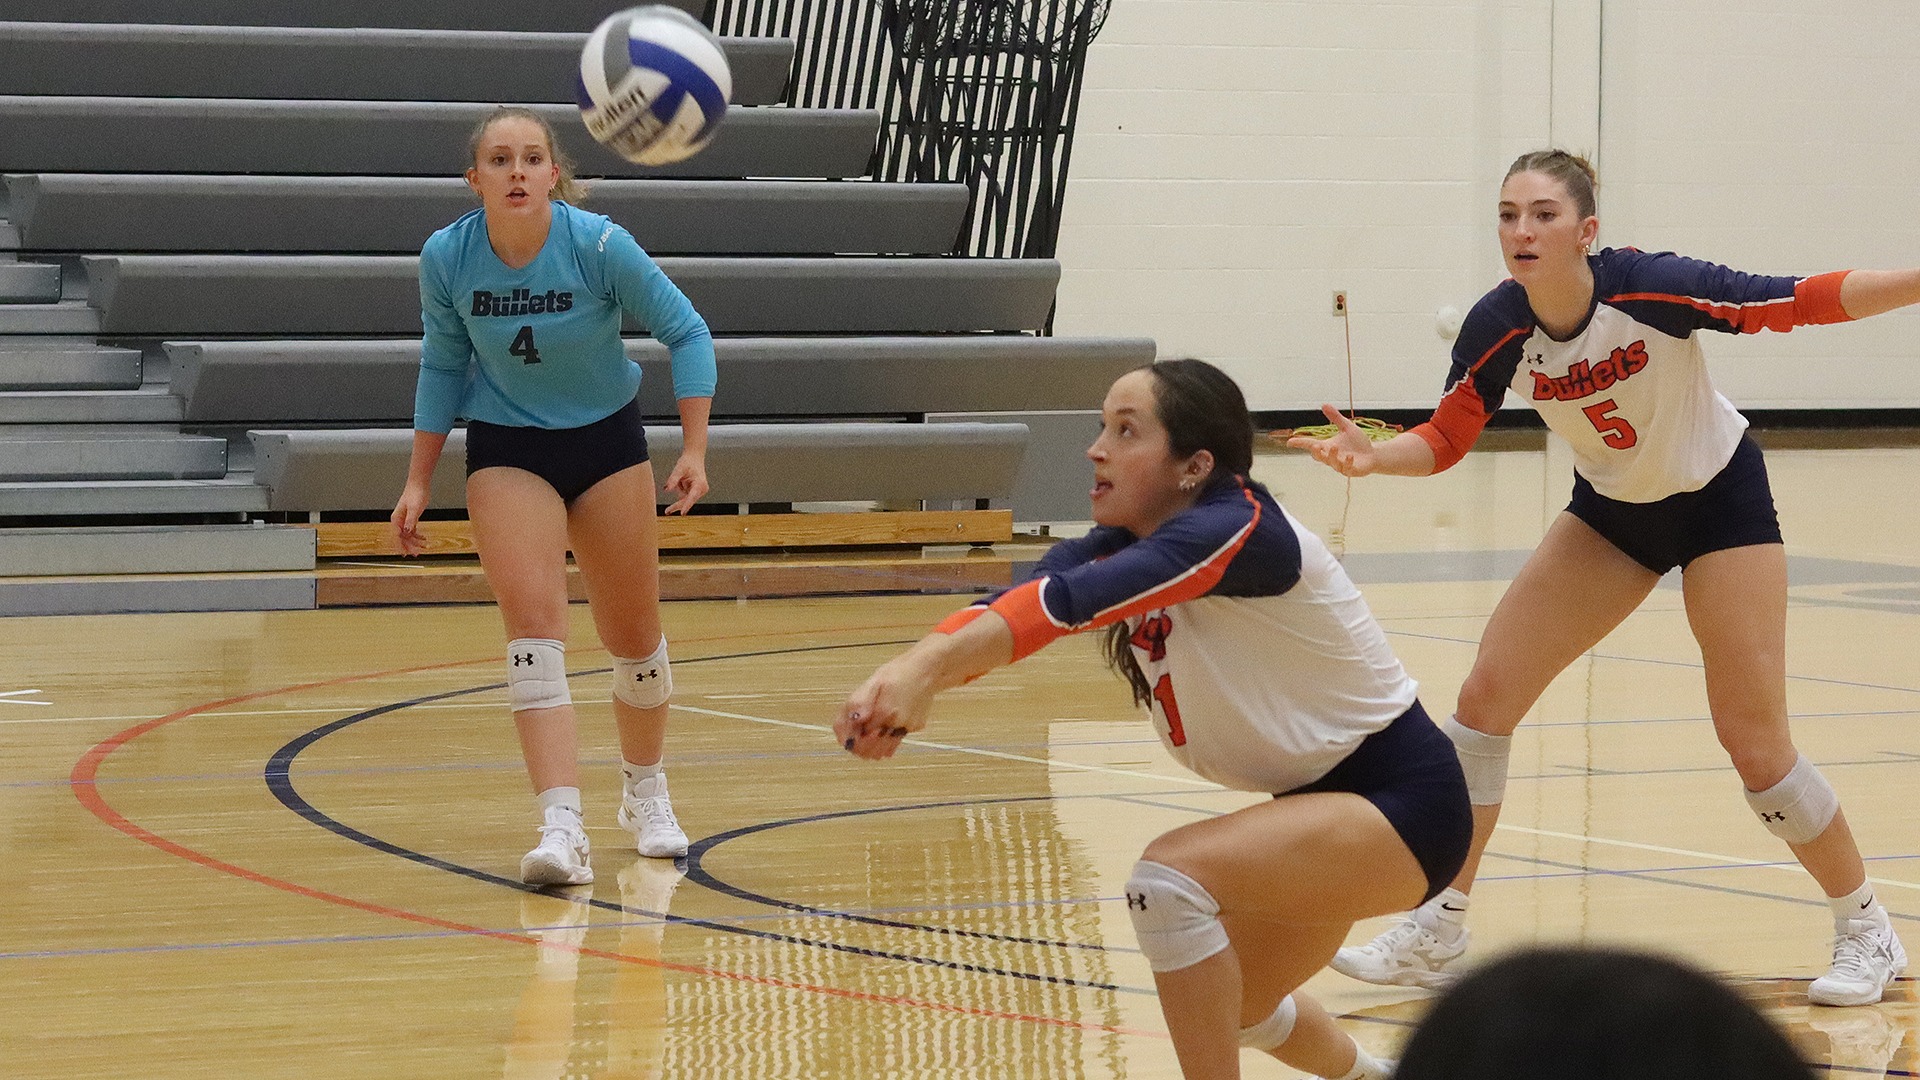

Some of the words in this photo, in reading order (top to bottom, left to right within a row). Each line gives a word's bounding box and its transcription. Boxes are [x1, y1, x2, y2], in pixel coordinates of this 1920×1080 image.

[471, 288, 573, 317] Bullets
[508, 325, 541, 365] 4
[1529, 339, 1649, 402] Bullets
[1581, 398, 1638, 450] 5
